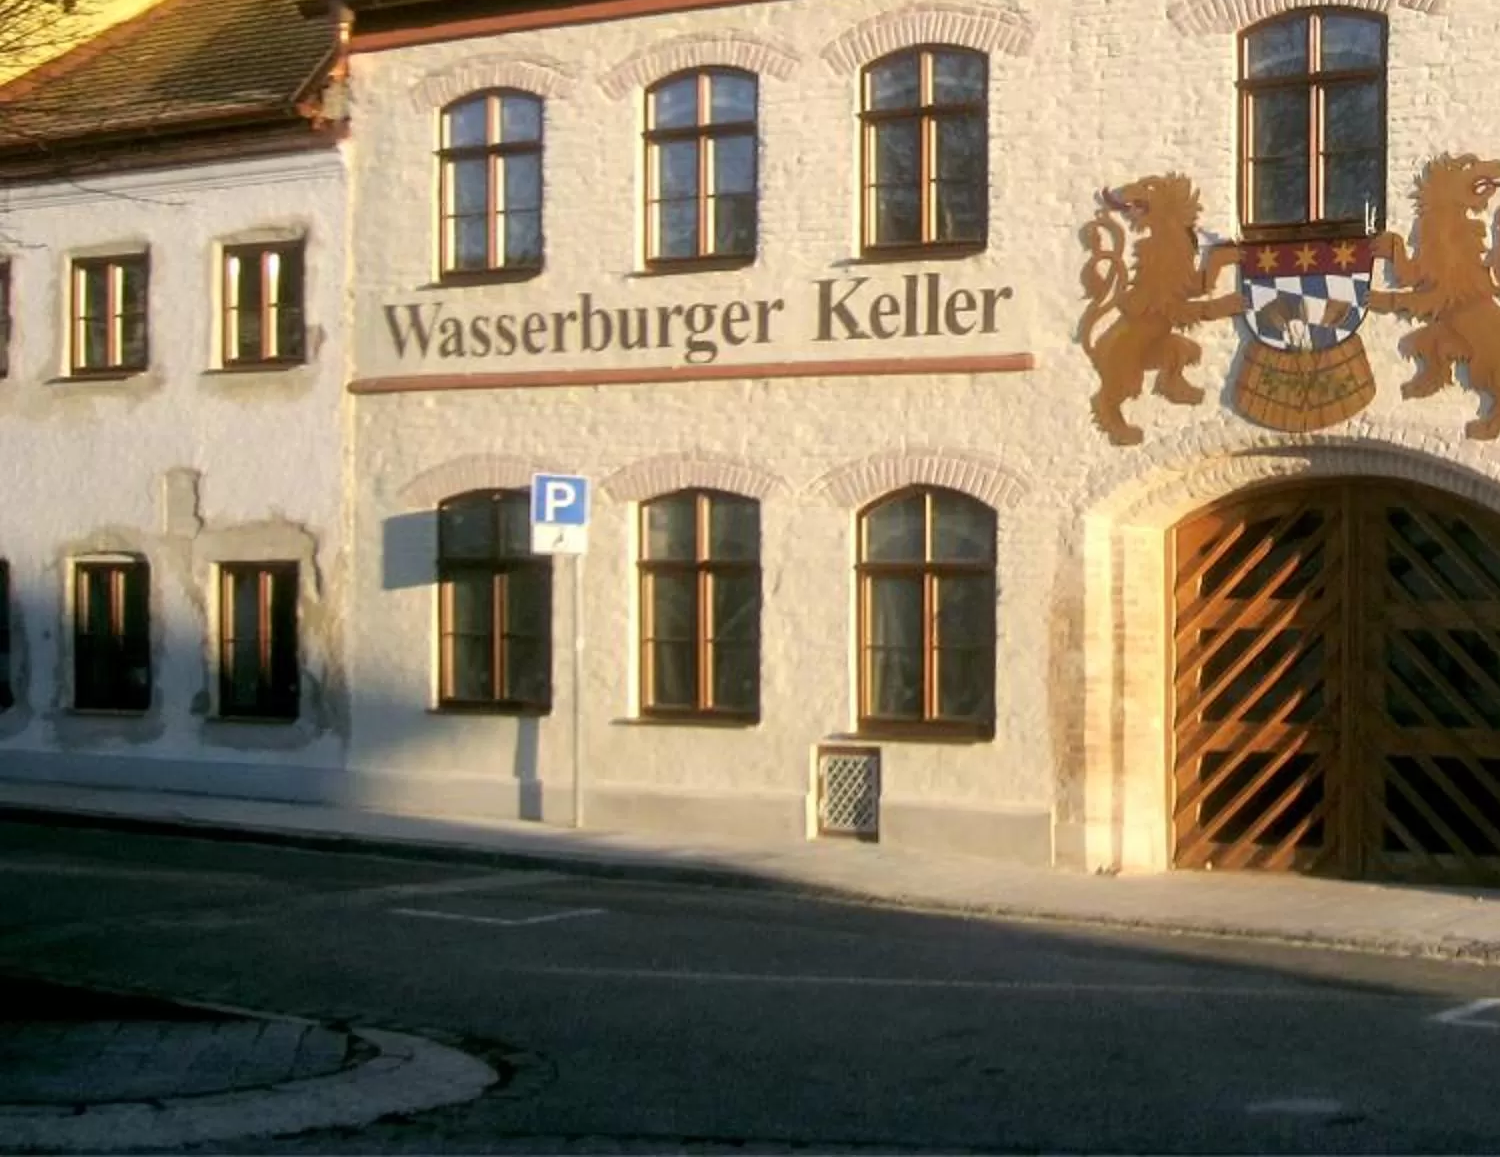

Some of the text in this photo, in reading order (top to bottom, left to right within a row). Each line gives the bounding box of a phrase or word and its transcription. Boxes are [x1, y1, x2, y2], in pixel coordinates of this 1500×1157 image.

[382, 272, 1013, 365] Wasserburger Keller
[544, 481, 576, 523] P
